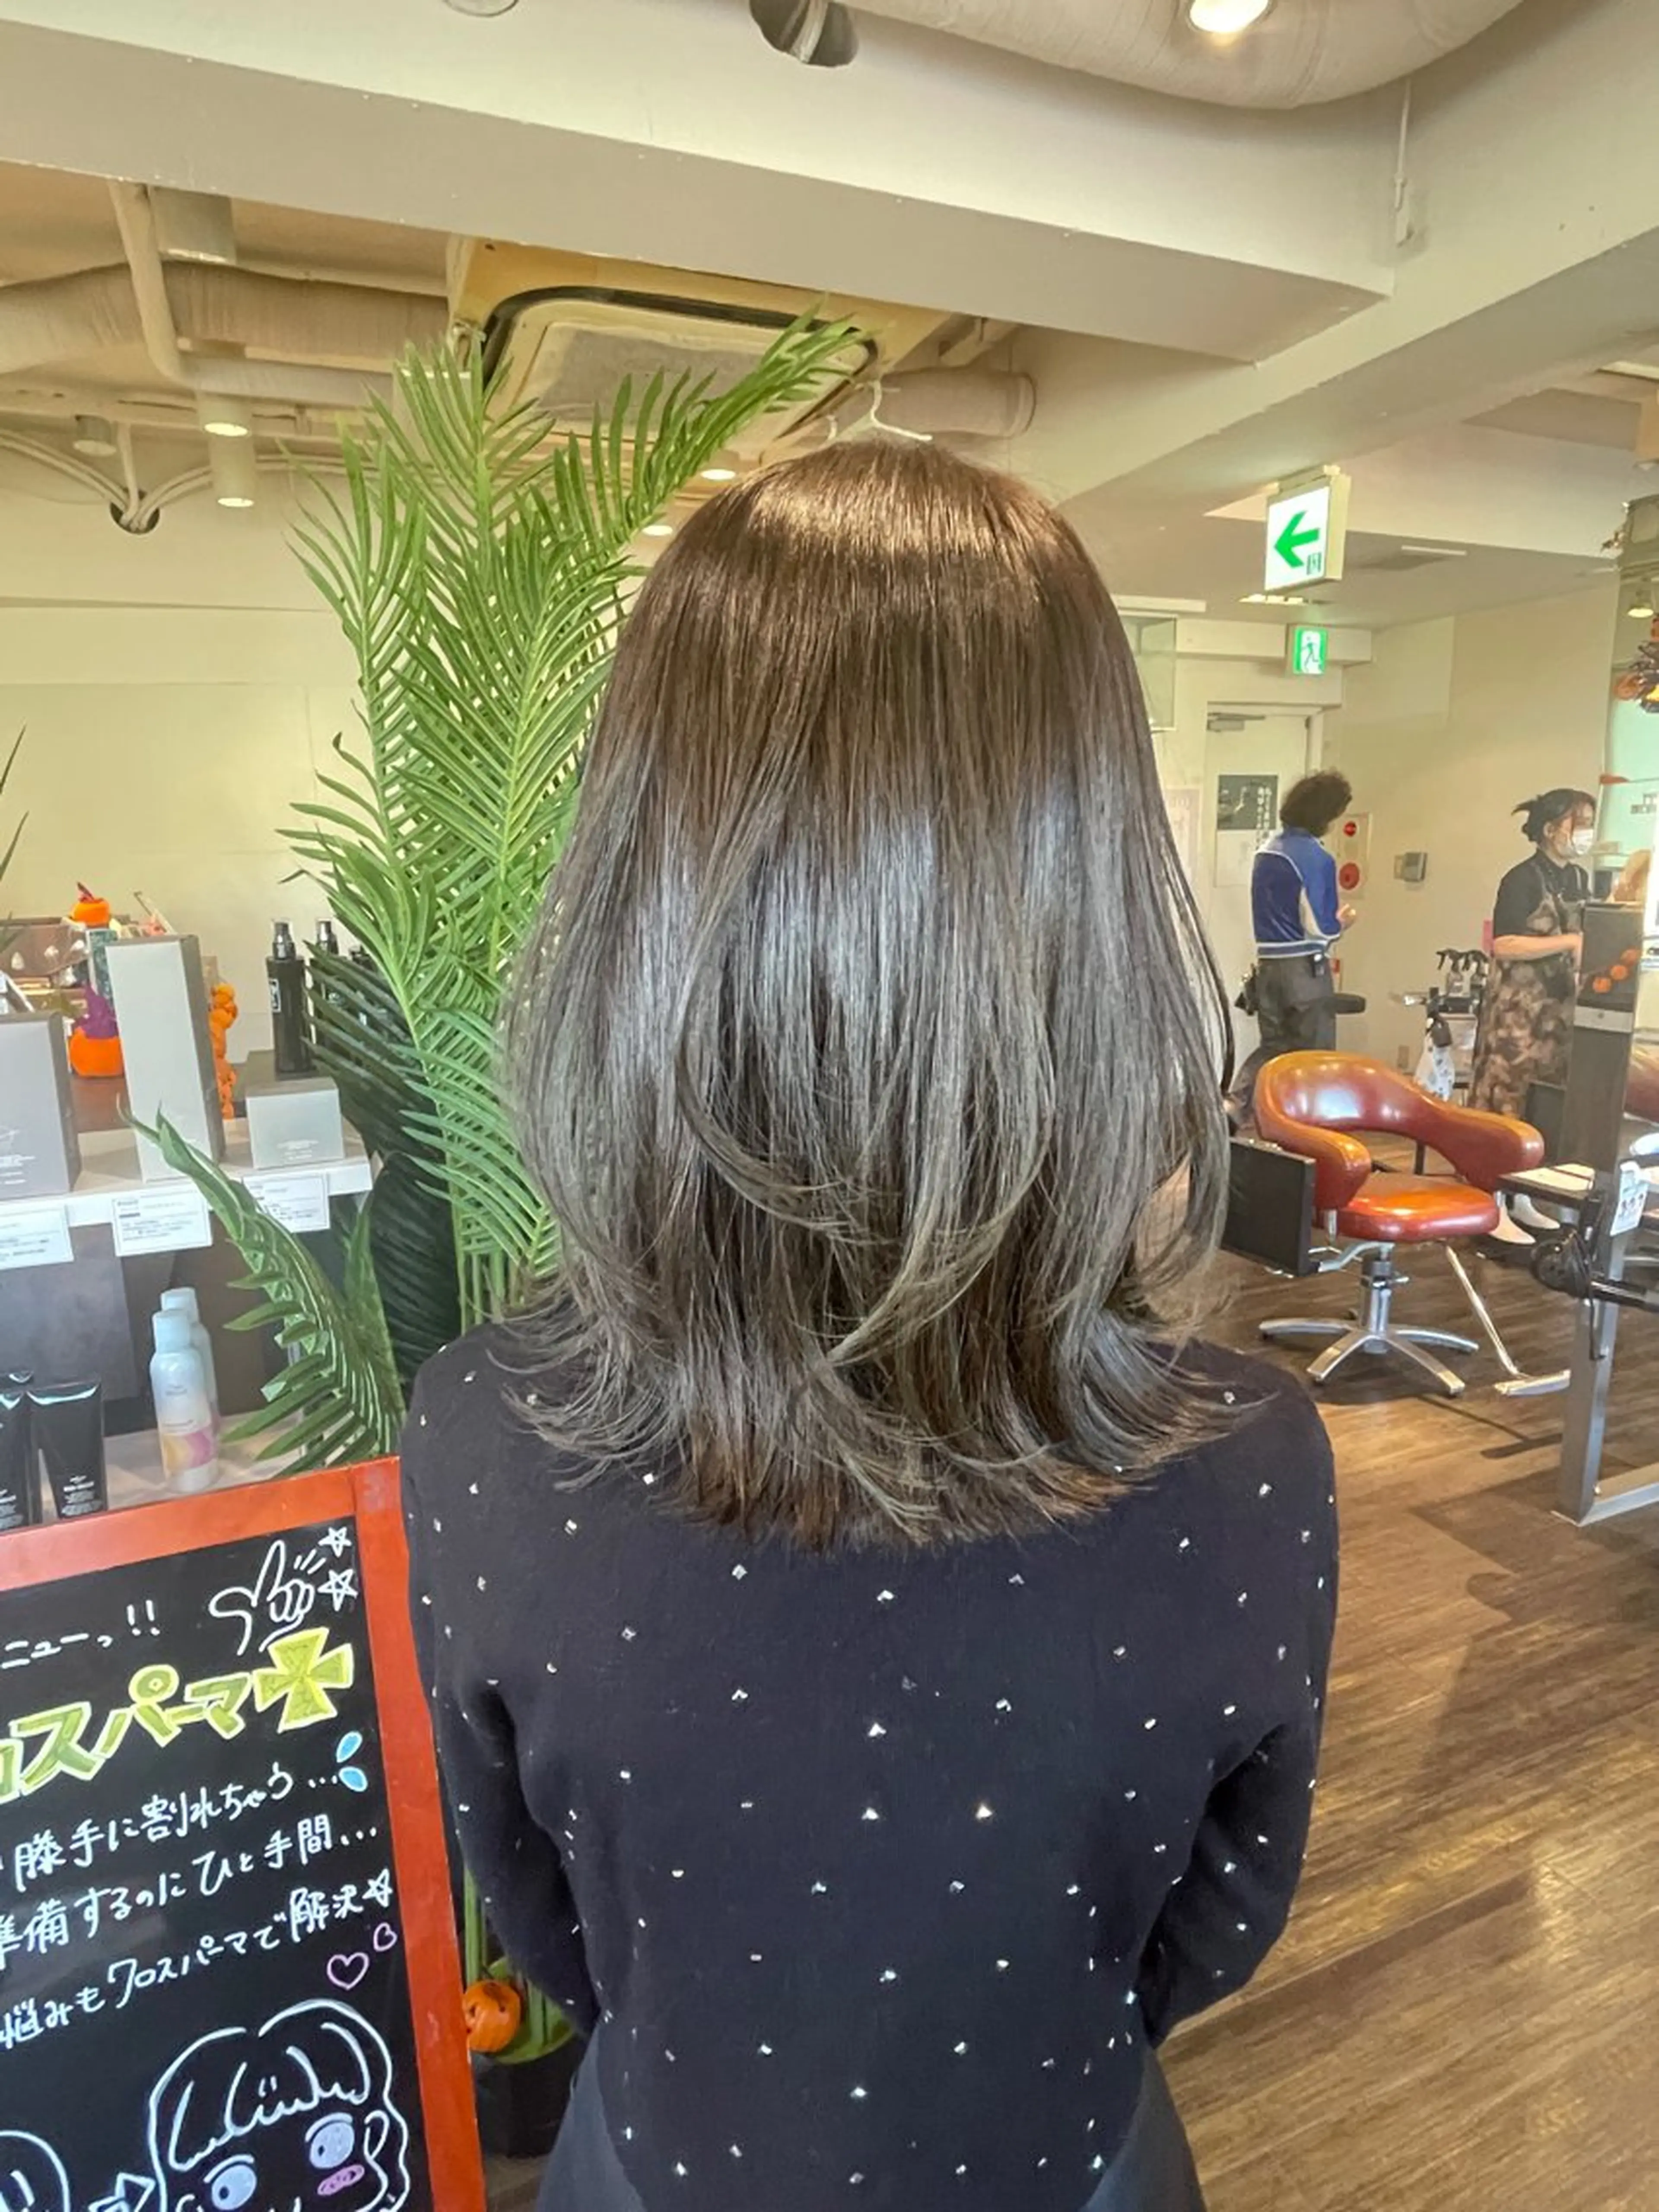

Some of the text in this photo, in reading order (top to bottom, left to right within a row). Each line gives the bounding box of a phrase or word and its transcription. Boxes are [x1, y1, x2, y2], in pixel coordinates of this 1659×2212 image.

[0, 1762, 337, 1892] 勝手に割れちゃう...
